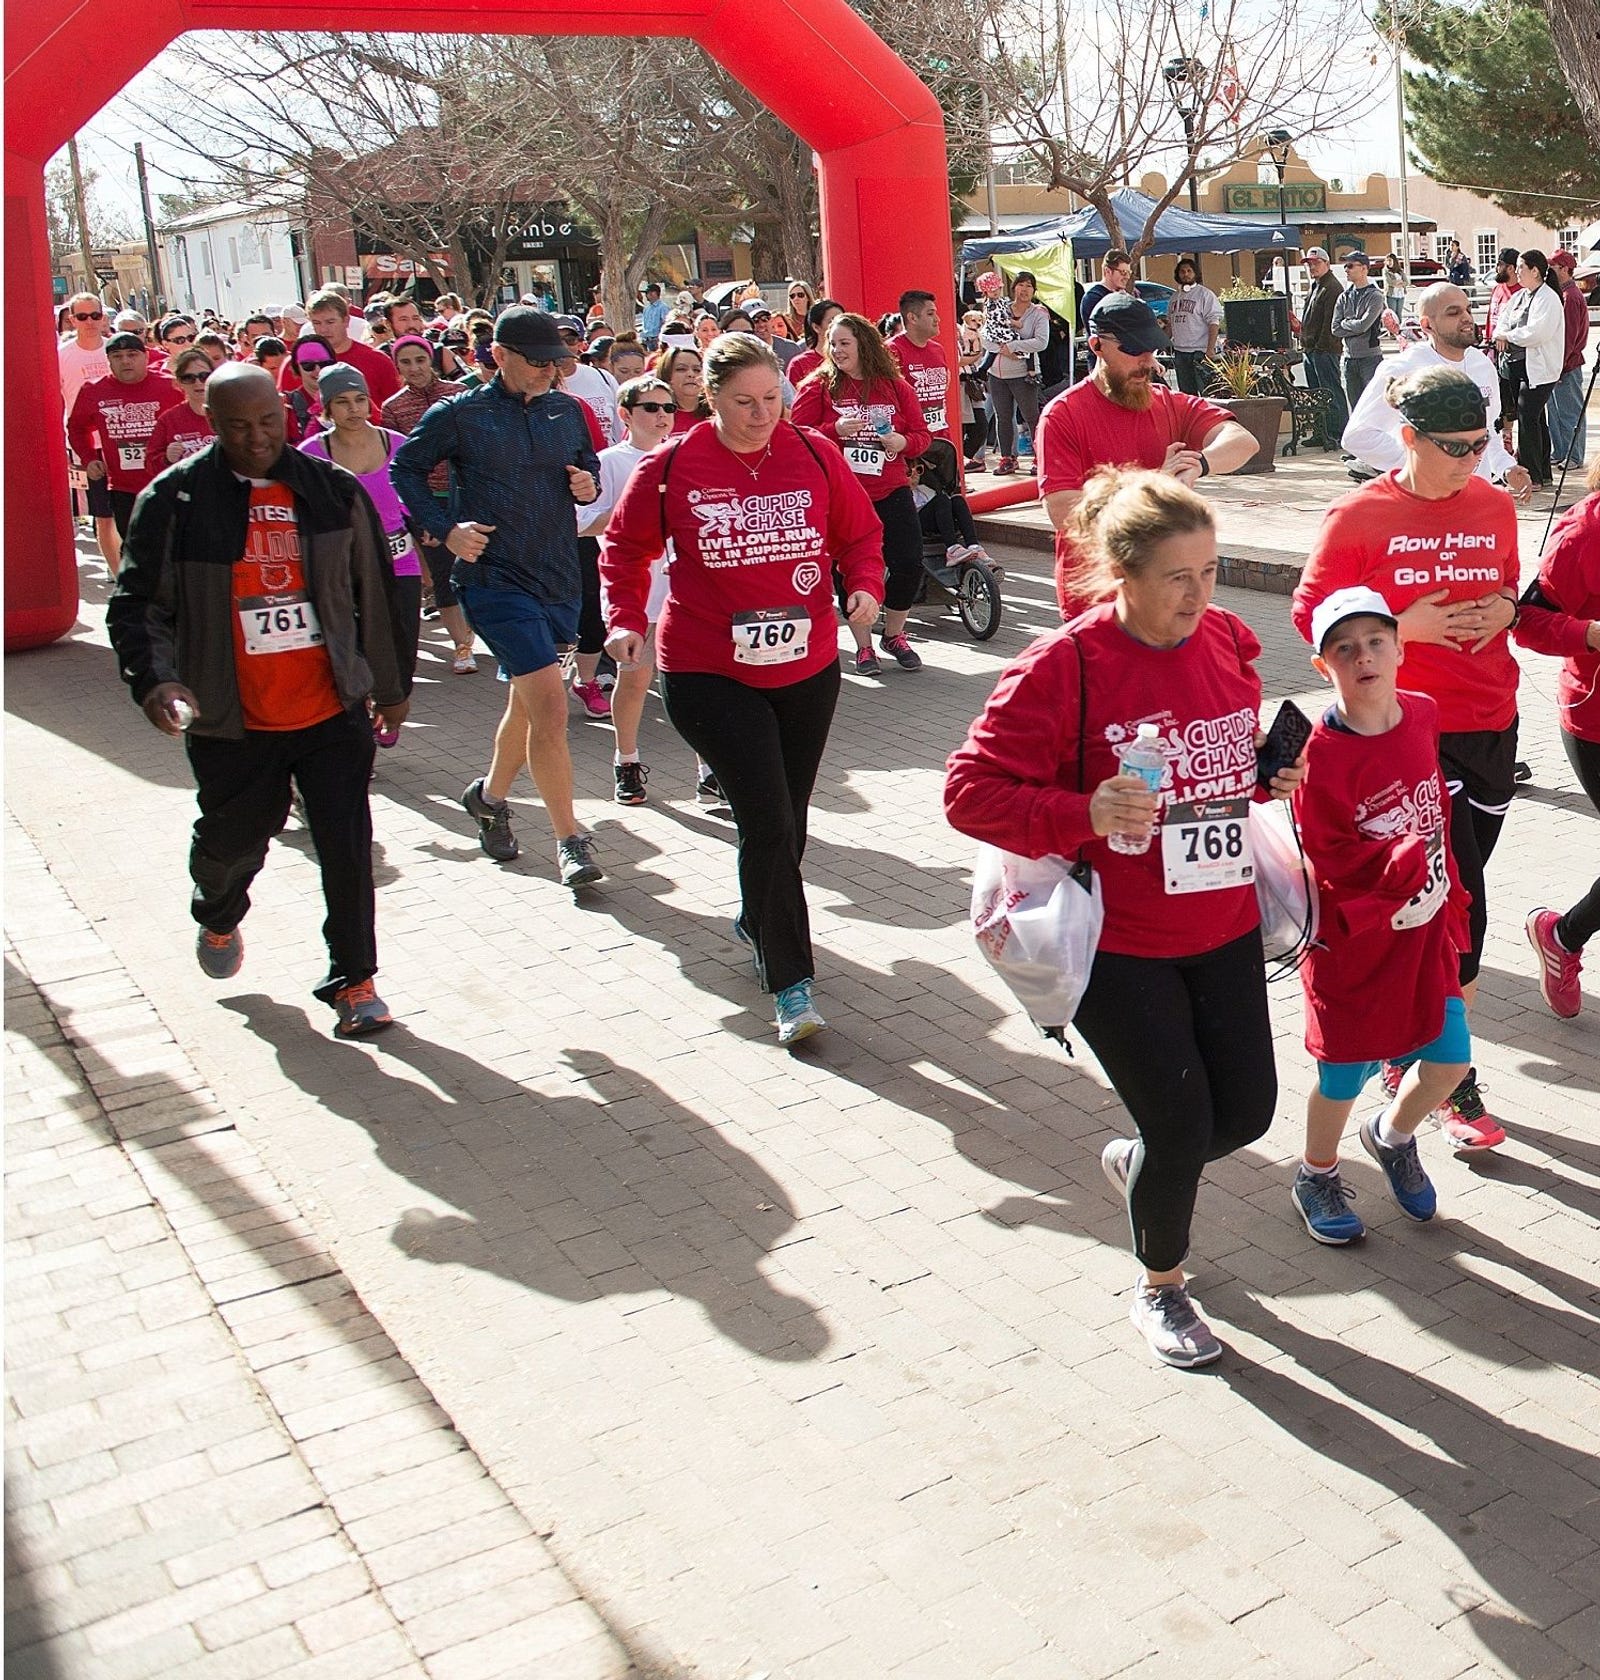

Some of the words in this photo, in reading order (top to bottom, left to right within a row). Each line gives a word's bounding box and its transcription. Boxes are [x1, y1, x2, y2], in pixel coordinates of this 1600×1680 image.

[925, 412, 941, 425] 591
[851, 449, 879, 464] 406
[742, 490, 813, 515] CUPID'S
[741, 508, 807, 532] CHASE
[725, 549, 741, 560] IN
[746, 541, 807, 557] SUPPORT
[811, 537, 824, 548] OF
[1387, 535, 1442, 556] Row
[1444, 532, 1496, 550] Hard
[1439, 551, 1457, 561] or
[703, 560, 739, 569] PEOPLE
[741, 555, 766, 566] WITH
[1394, 567, 1430, 586] Go
[1435, 564, 1500, 582] Home
[255, 605, 307, 635] 761
[746, 622, 796, 649] 760
[1184, 708, 1258, 751] CUPID'S
[1181, 823, 1243, 863] 768
